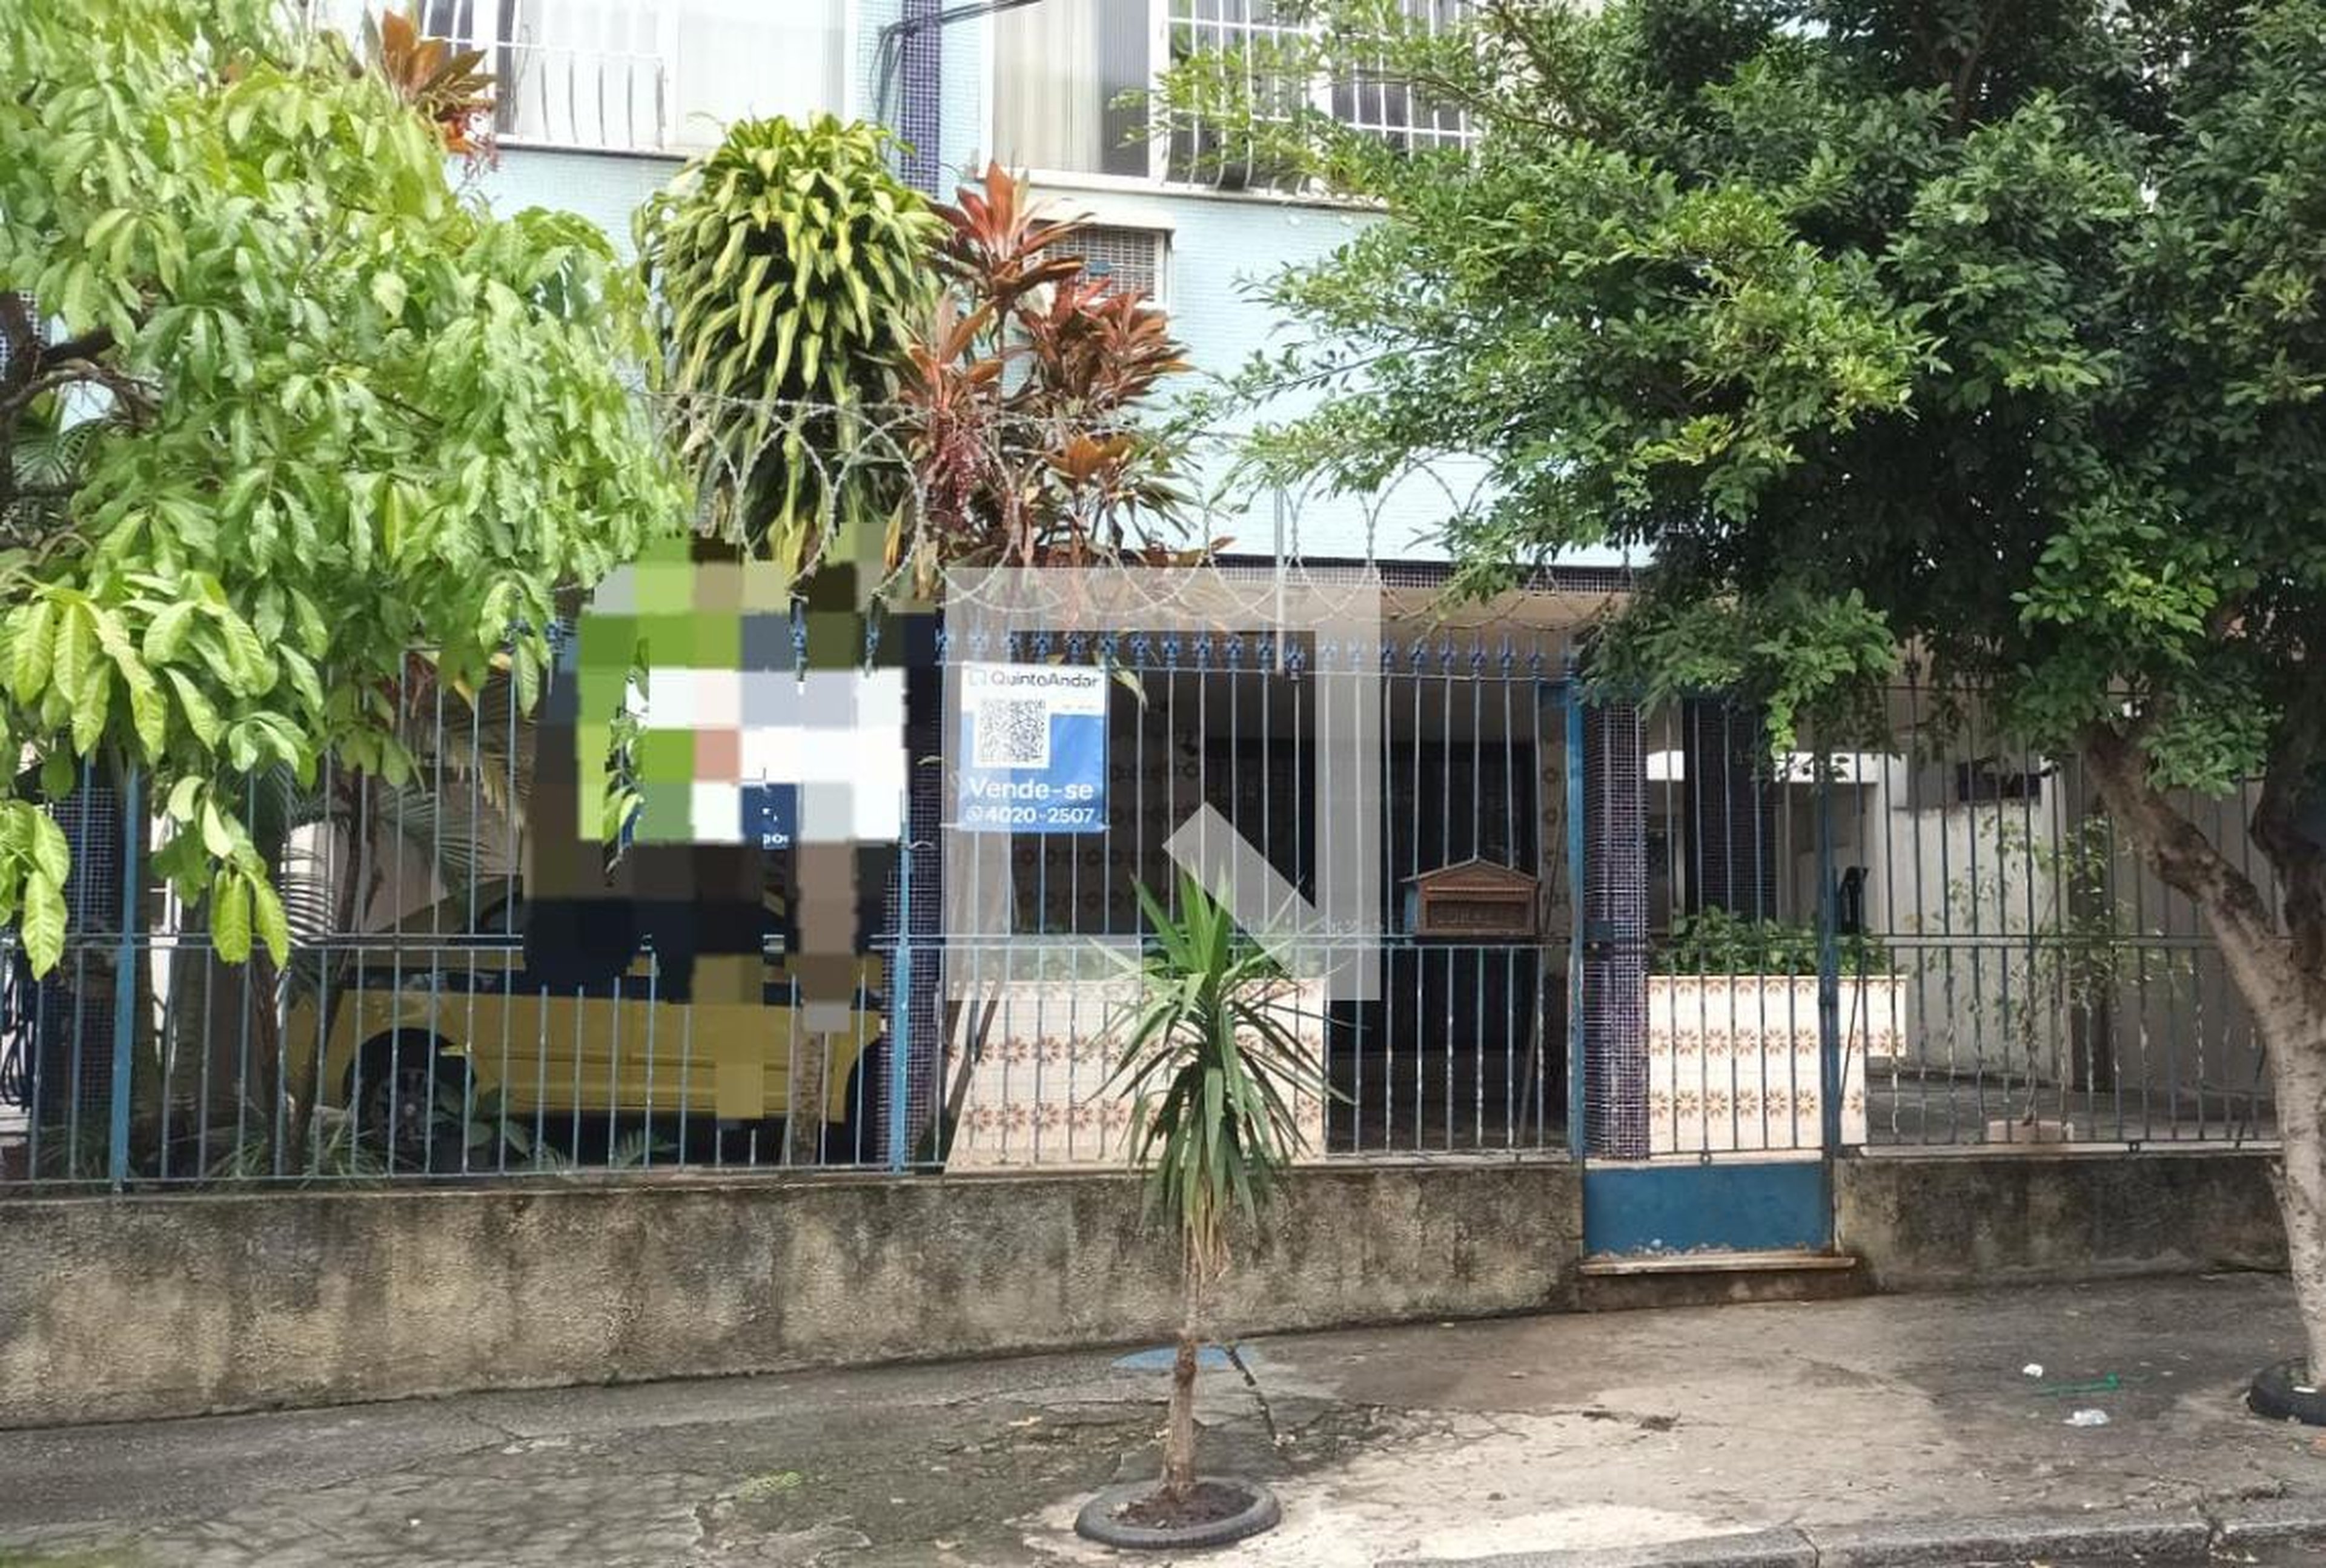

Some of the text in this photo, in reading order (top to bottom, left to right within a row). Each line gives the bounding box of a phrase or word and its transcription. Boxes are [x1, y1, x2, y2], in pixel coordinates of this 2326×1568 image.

[990, 670, 1100, 688] QuintoAndar
[969, 778, 1094, 800] Vende-se
[987, 808, 1095, 824] 4020-2507
